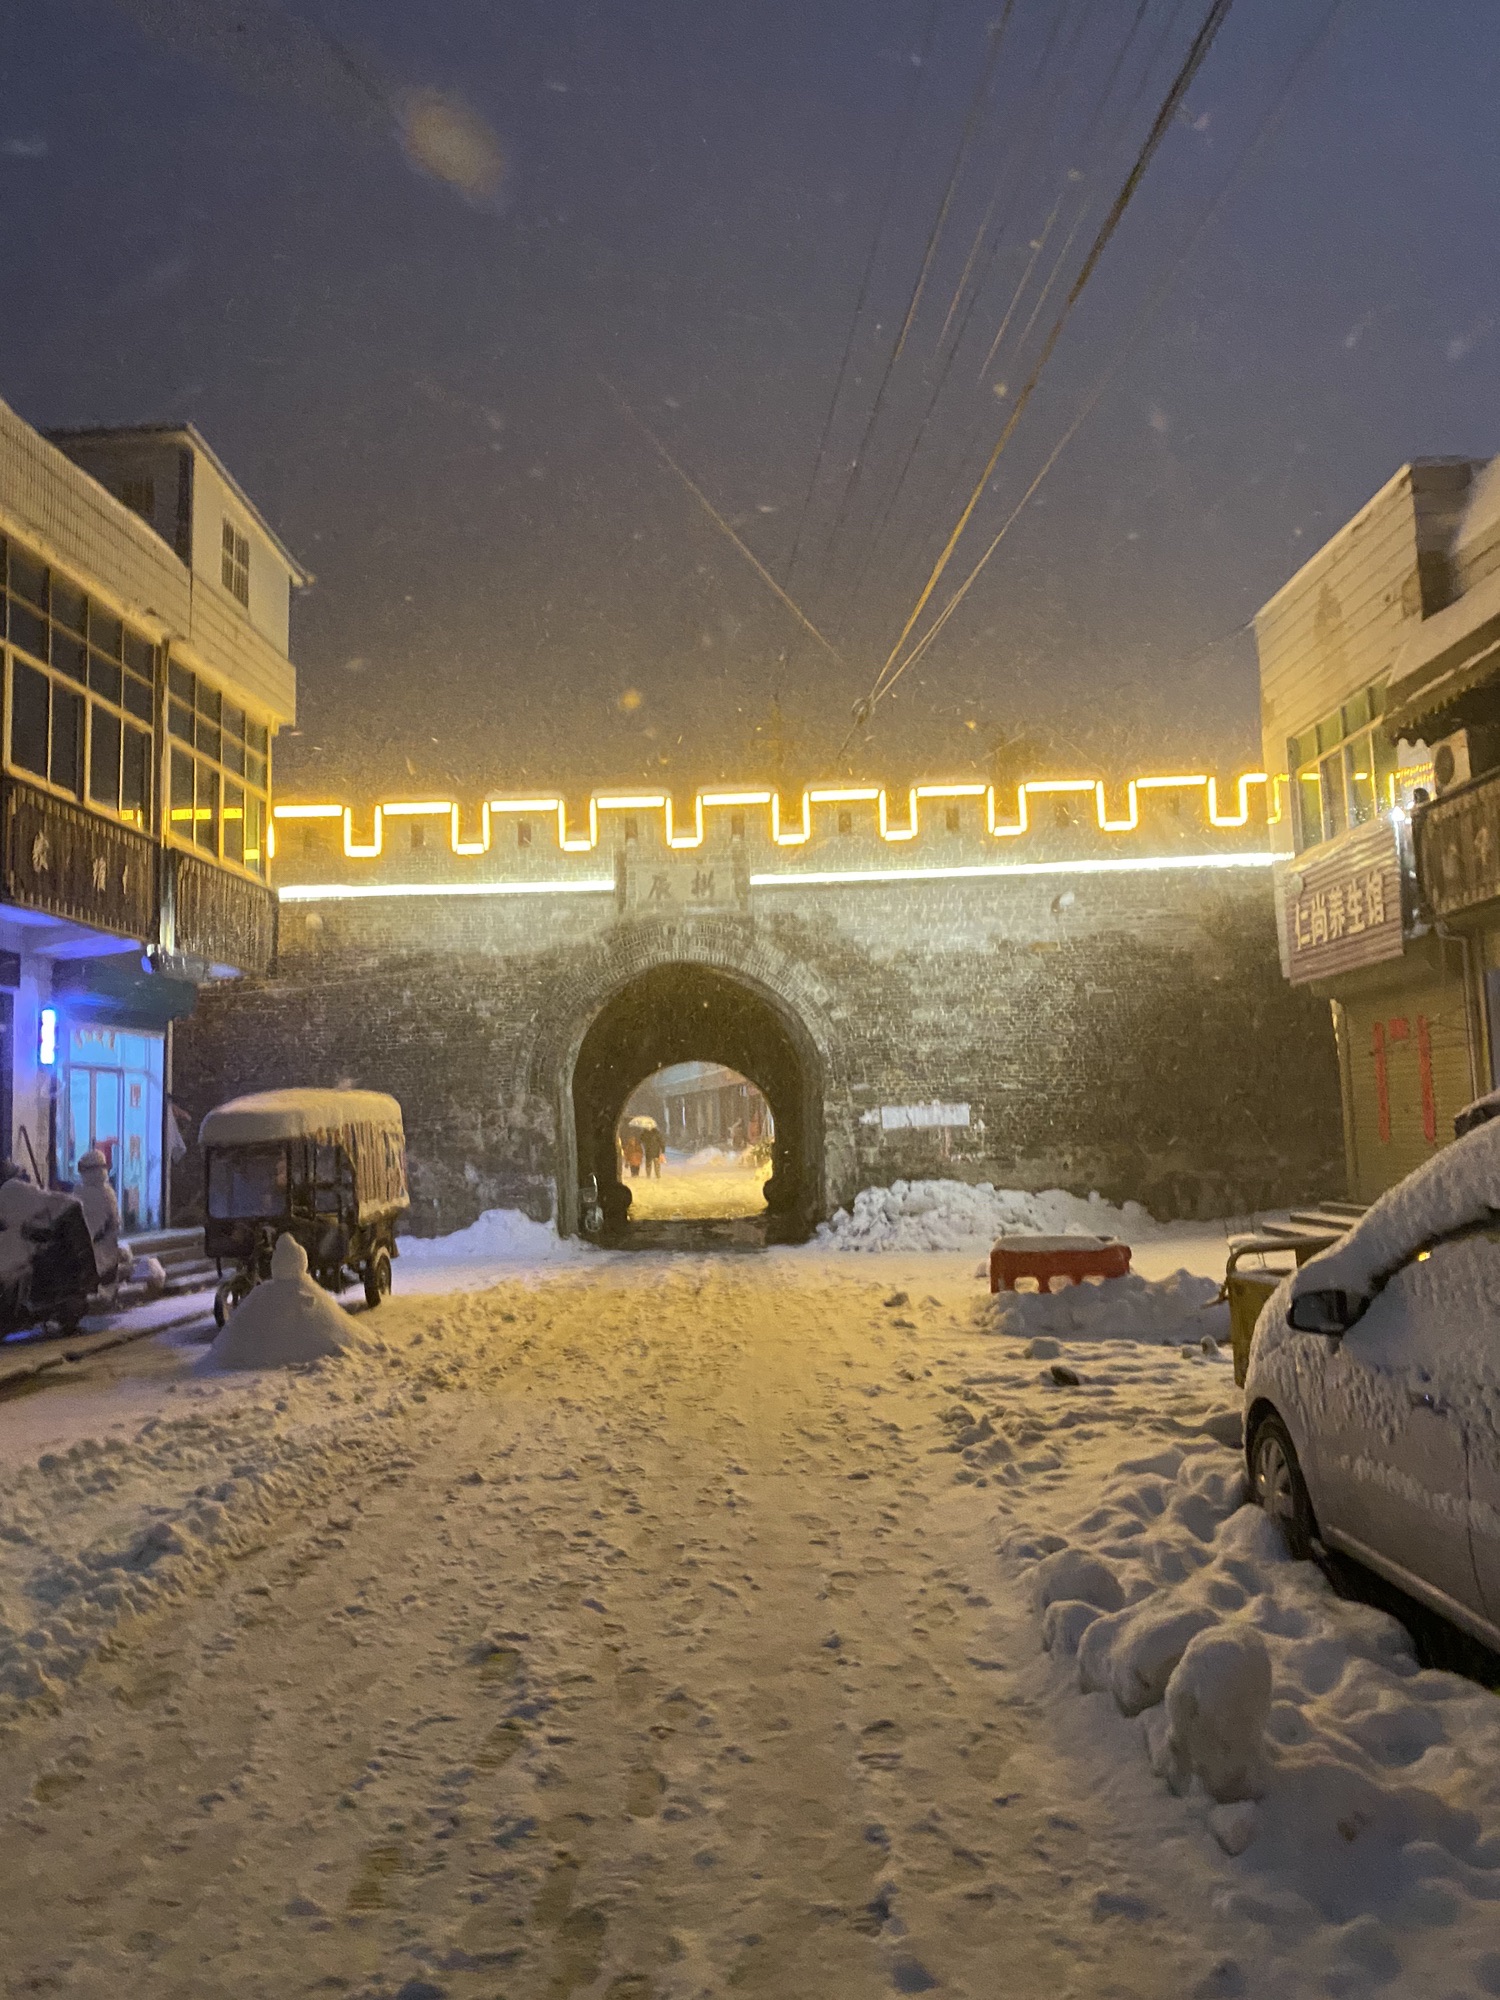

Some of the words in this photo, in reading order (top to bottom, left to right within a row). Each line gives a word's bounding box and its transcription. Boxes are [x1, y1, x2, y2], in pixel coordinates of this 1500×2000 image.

[1294, 870, 1386, 951] 仁尚养生馆
